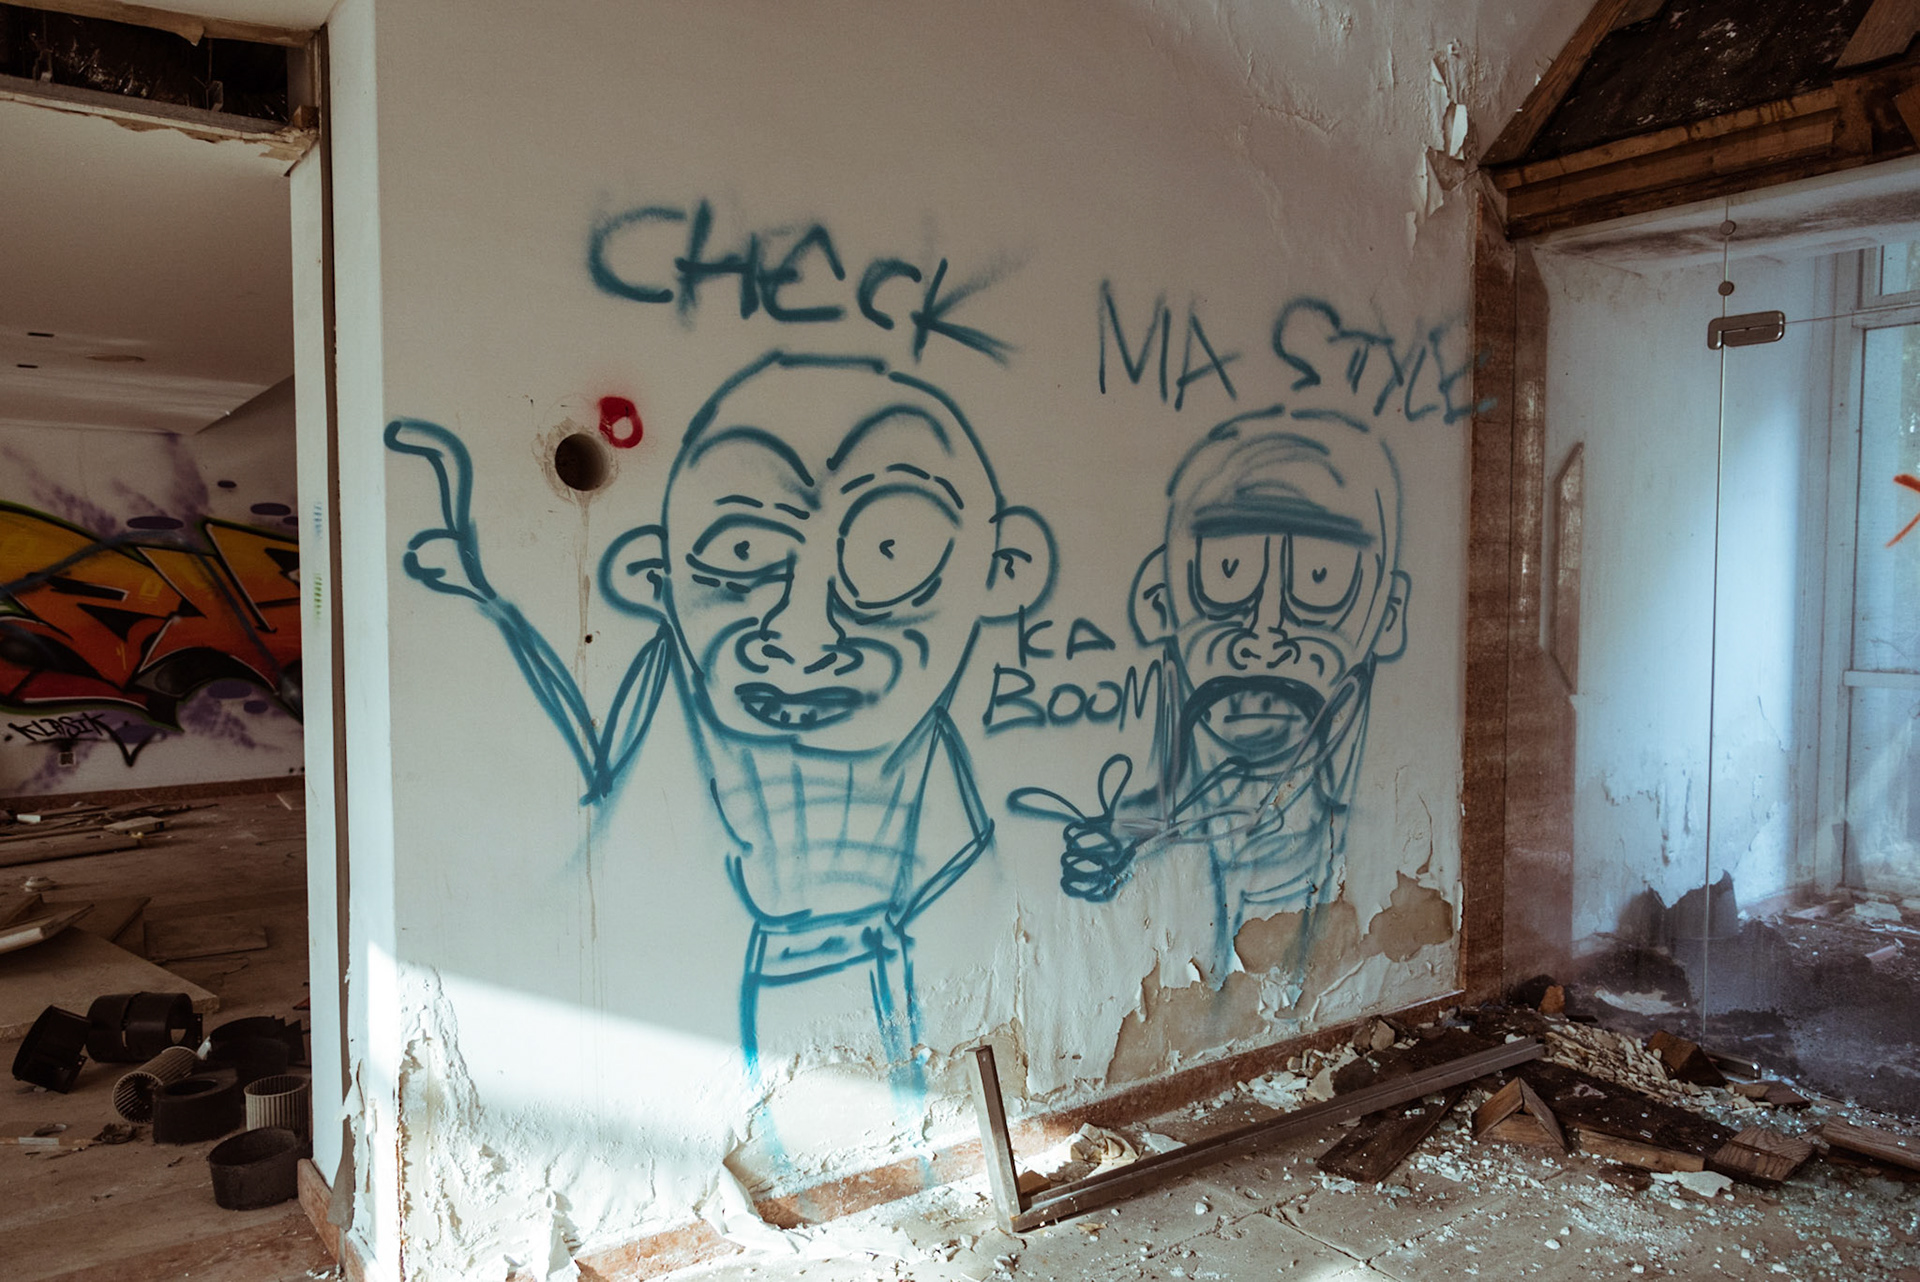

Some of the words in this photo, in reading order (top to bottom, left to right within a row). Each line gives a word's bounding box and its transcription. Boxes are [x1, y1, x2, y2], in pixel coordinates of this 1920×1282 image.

[588, 198, 1016, 364] CHECK
[1099, 279, 1241, 412] MA
[1271, 297, 1497, 425] STYLE
[1018, 603, 1116, 668] KA
[982, 658, 1163, 738] BOOM
